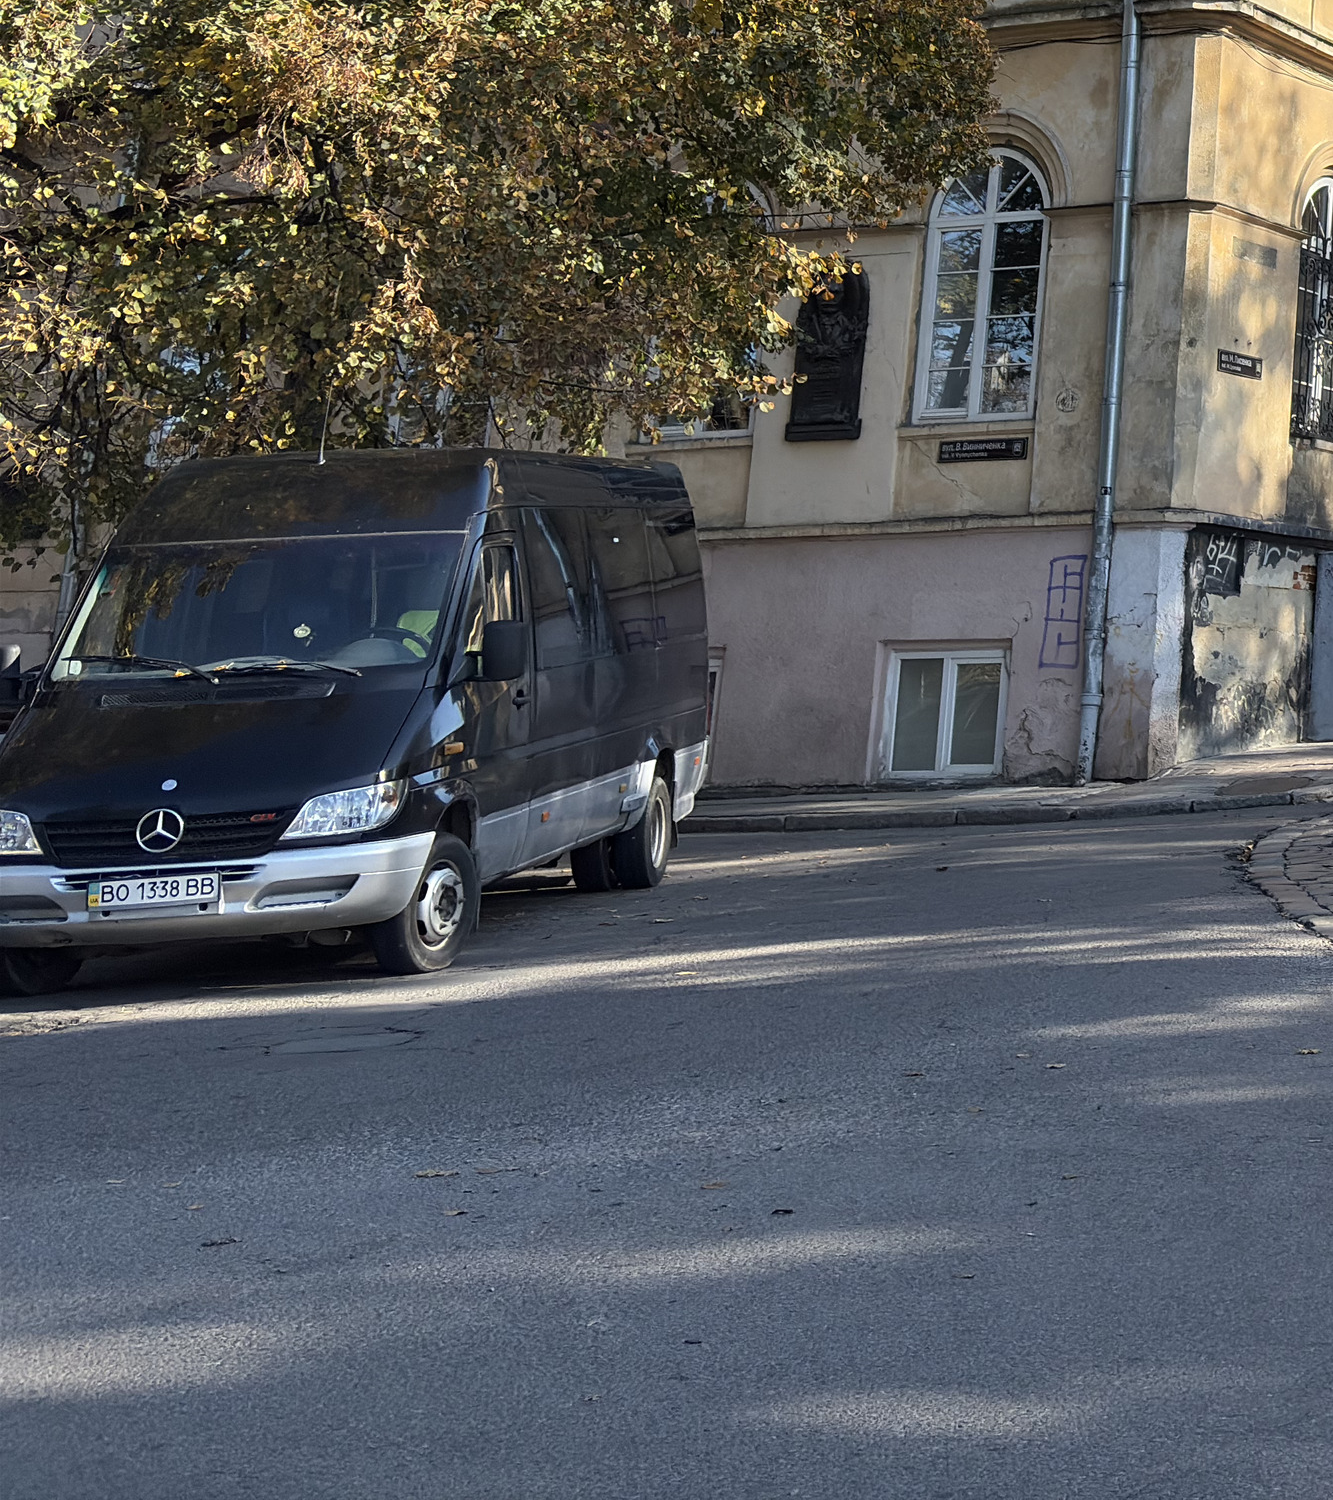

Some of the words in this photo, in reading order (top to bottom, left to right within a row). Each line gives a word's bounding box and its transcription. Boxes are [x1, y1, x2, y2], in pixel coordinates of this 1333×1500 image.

[962, 442, 1006, 451] Винниченка
[101, 885, 130, 903] BO
[137, 880, 180, 900] 1338
[186, 877, 215, 897] BB
